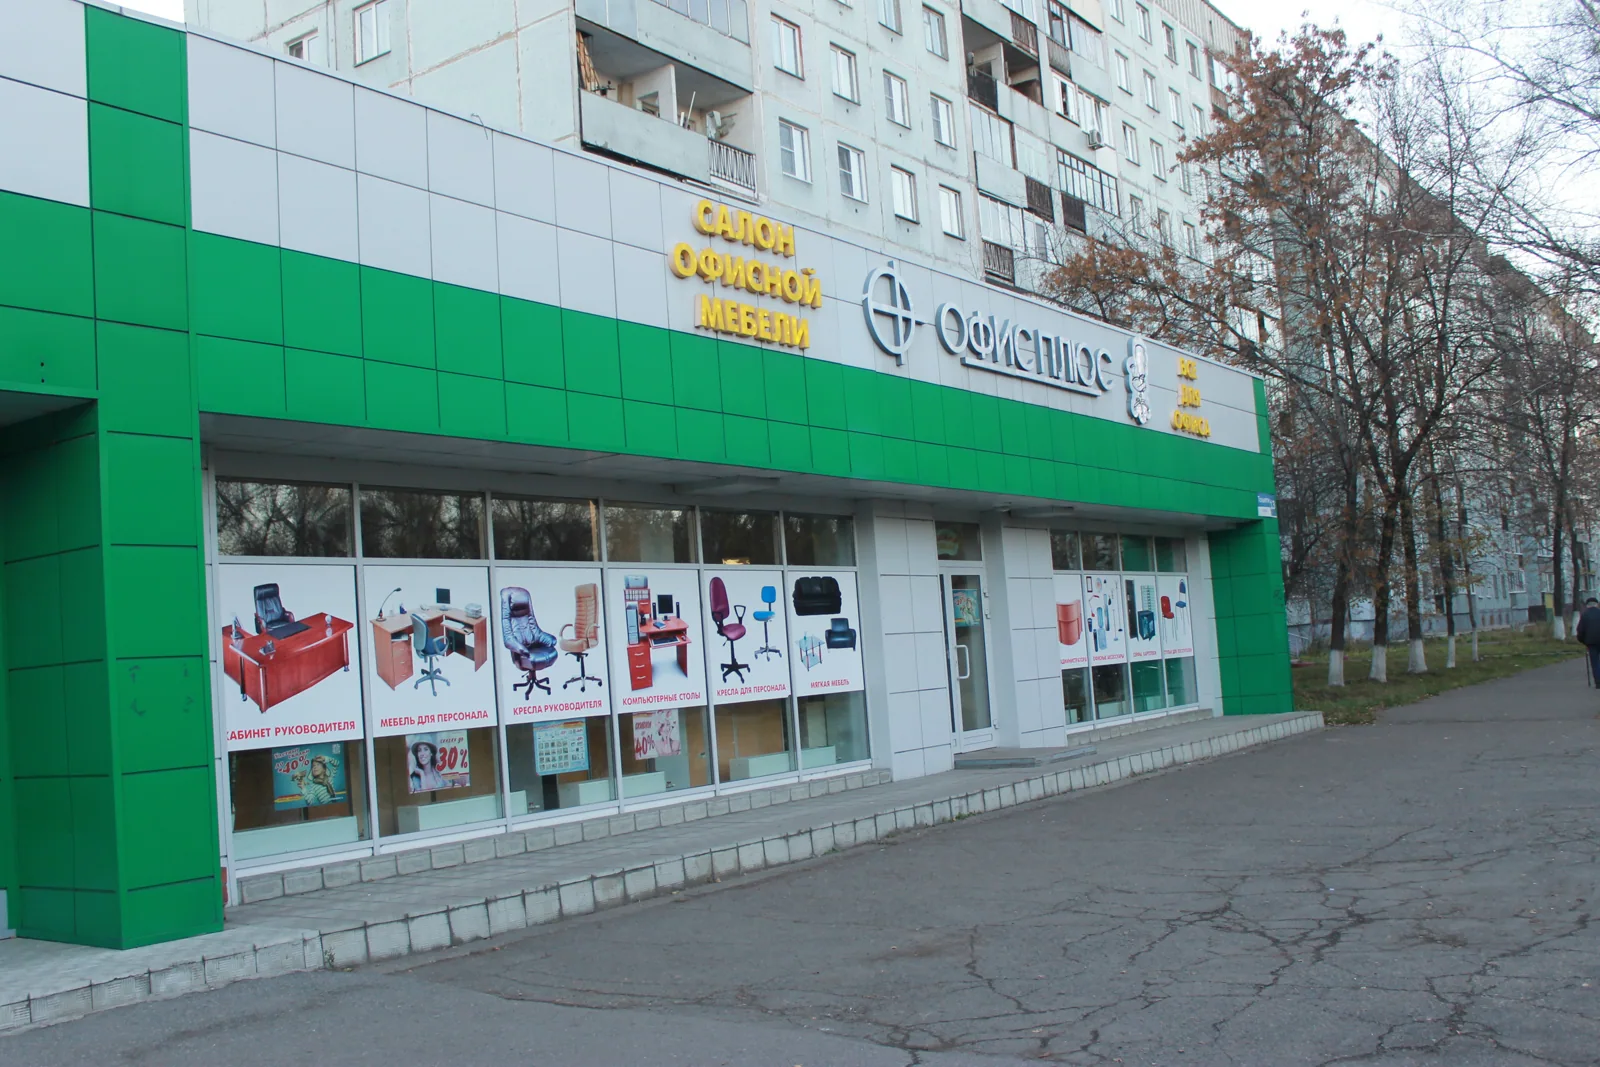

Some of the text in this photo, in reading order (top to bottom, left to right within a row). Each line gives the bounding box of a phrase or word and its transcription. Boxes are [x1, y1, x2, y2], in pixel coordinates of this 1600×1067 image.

[692, 199, 795, 258] САЛОН
[668, 242, 823, 309] ОФИСНОЙ
[694, 294, 810, 350] МЕБЕЛИ
[935, 301, 1114, 392] ОФИСПЛЮС
[1178, 383, 1201, 408] ДЛЯ
[1170, 409, 1211, 438] ОФИСА
[716, 683, 786, 698] КРЕСЛА ДЛЯ ПЕРСОНАЛА
[810, 678, 850, 689] МЯГКАЯ МЕБЕЛЬ
[513, 699, 603, 717] КРЕСЛА РУКОВОДИТЕЛЯ
[622, 691, 701, 706] КОМПЬЮТЕРНЫЕ СТОЛЫ
[275, 720, 356, 738] РУКОВОДИТЕЛЯ
[380, 710, 489, 728] МЕБЕЛЬ ДЛЯ ПЕРСОНАЛА
